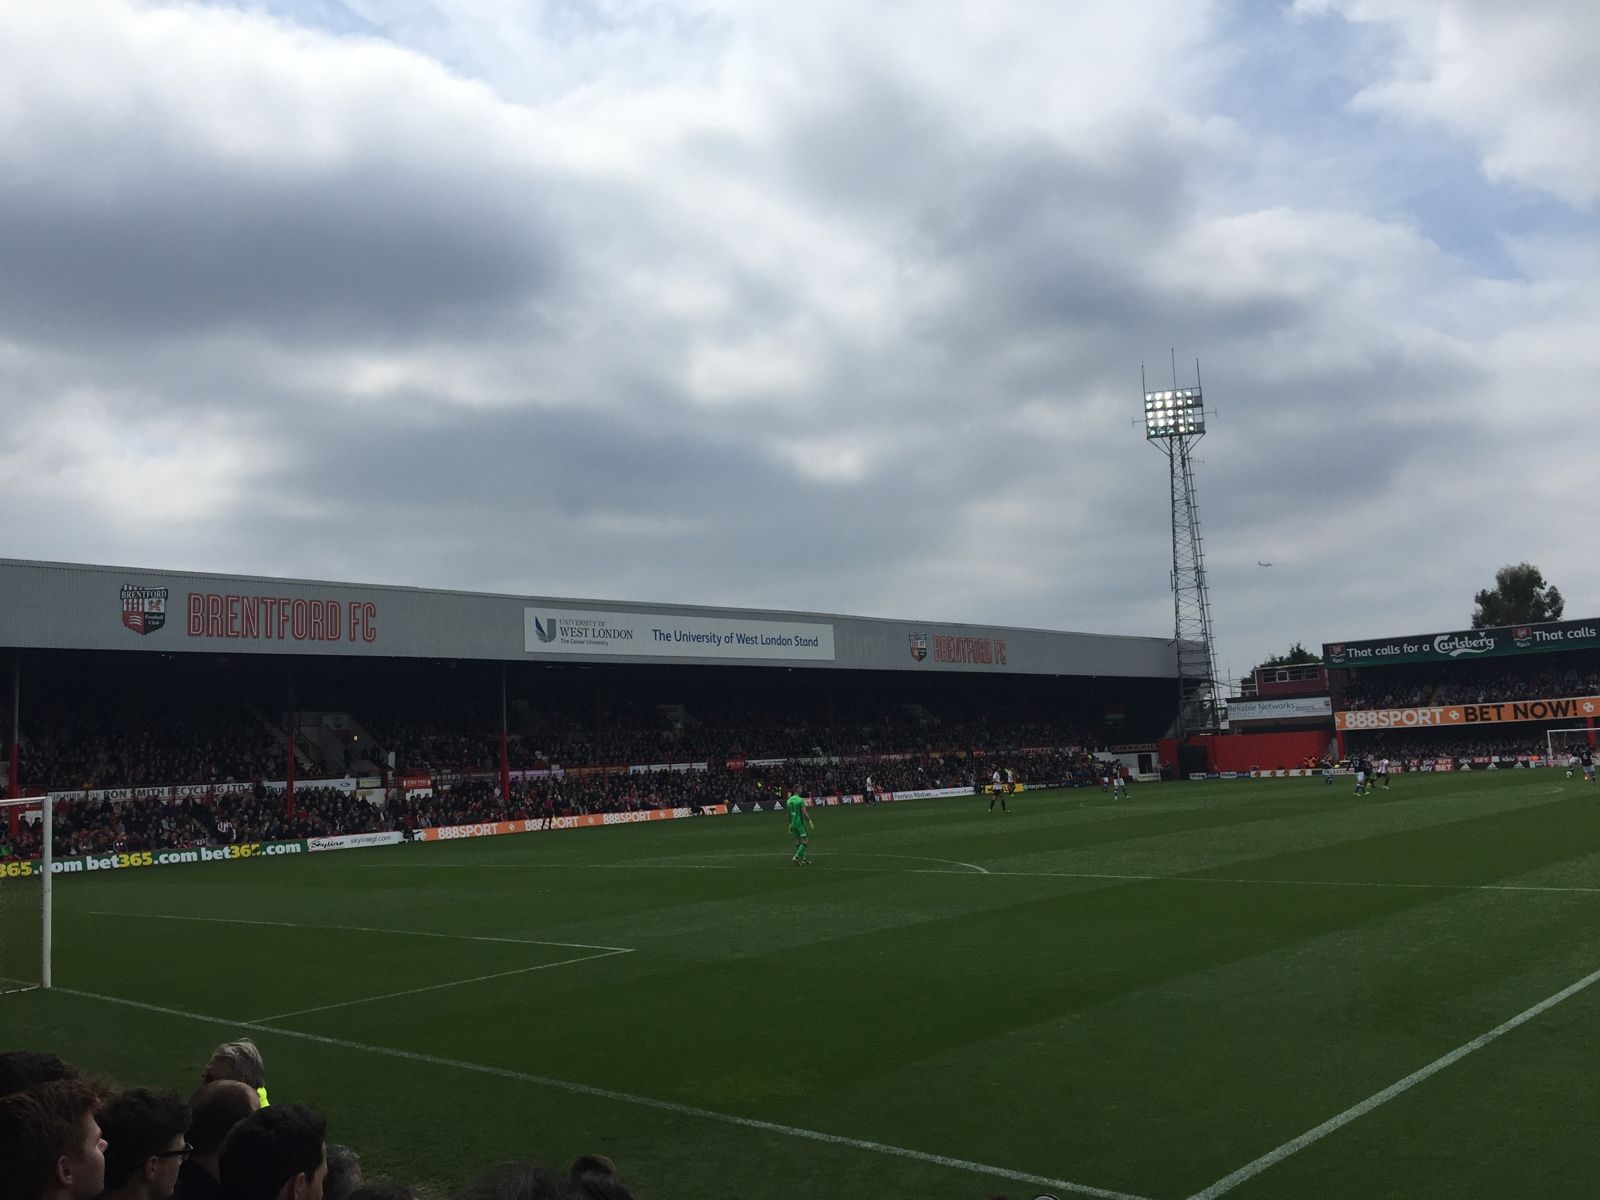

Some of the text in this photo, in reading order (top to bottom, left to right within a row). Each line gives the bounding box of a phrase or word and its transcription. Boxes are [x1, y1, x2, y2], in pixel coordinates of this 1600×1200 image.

[121, 590, 167, 599] BRENTFORD
[187, 593, 377, 642] BRENTFORD FC
[559, 619, 596, 627] UNIVERSITY
[560, 627, 633, 640] WEST LONDON
[652, 629, 819, 647] The University of West London Stand
[1532, 626, 1597, 642] That calls
[933, 635, 992, 664] BRENTFORD
[1346, 647, 1373, 659] That
[1375, 644, 1401, 656] calls
[1403, 642, 1419, 654] for
[1422, 643, 1431, 652] a
[1433, 634, 1496, 657] Carlsberg
[1227, 702, 1262, 713] Reliable
[1263, 701, 1297, 711] Networks
[1344, 699, 1578, 729] 888SPORT BET NOW!
[602, 810, 651, 825] 888SPORT
[437, 822, 498, 840] 888SPORT
[86, 850, 199, 870] bet365.com
[201, 842, 302, 861] bet365.com
